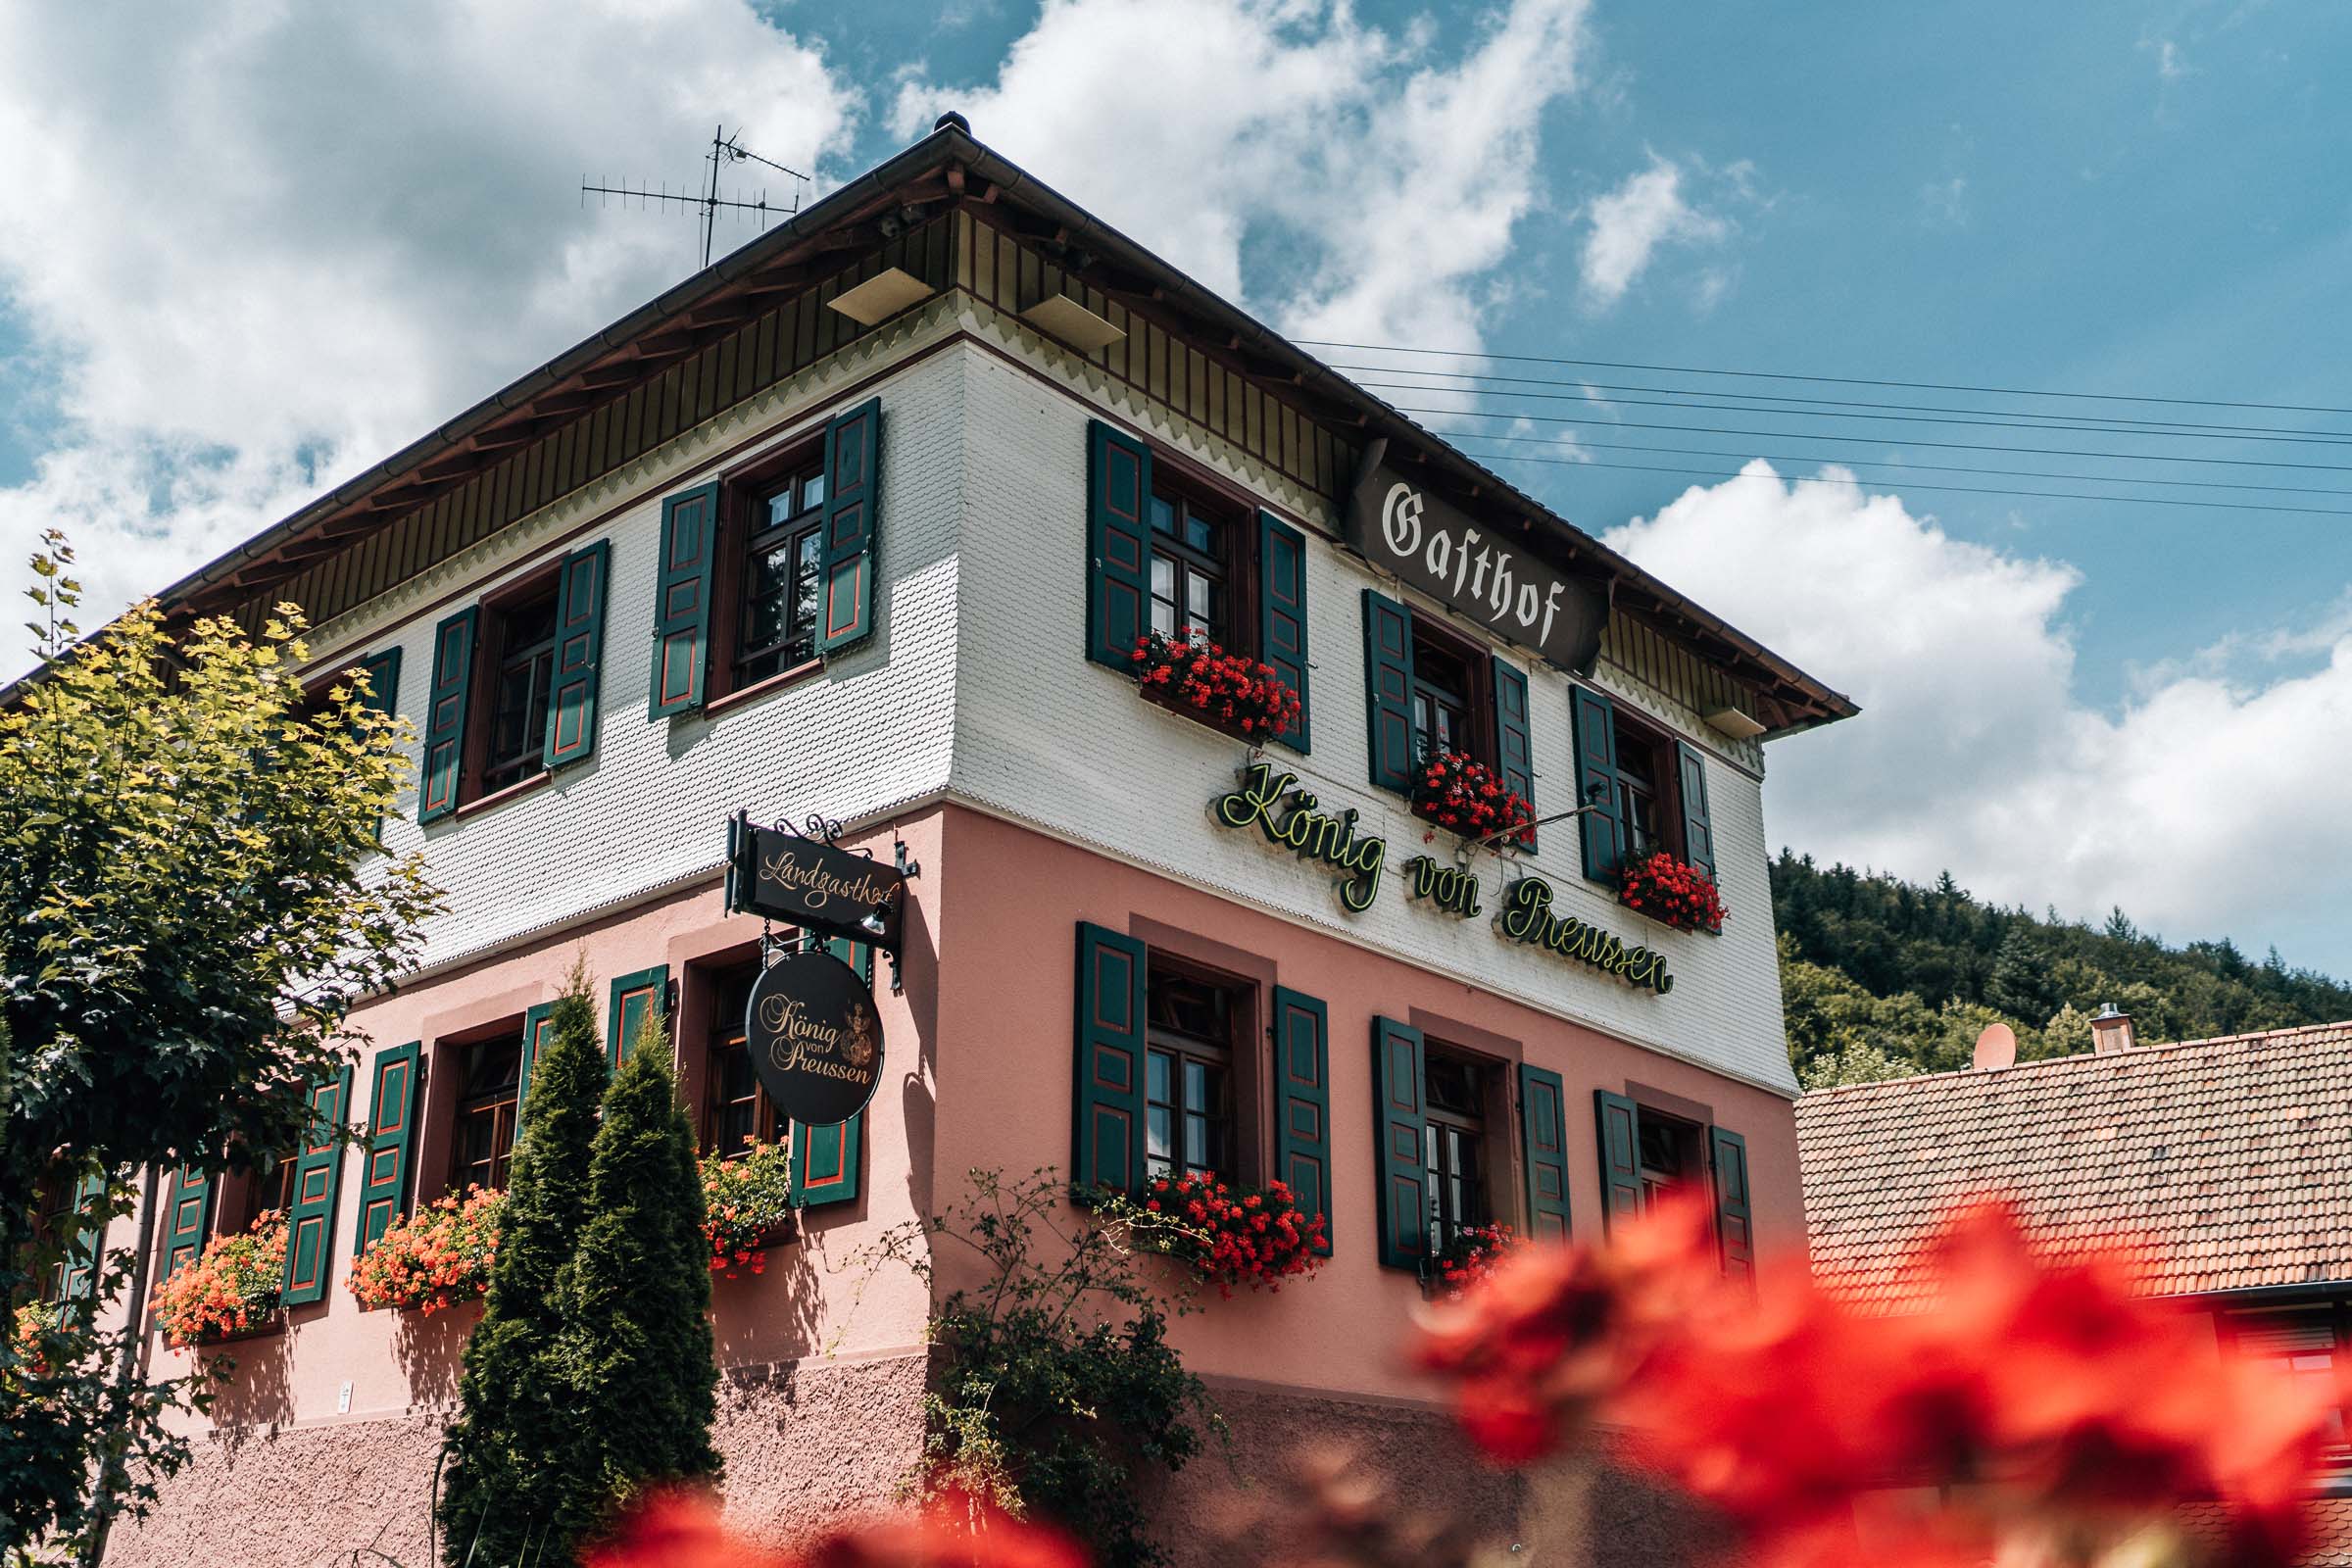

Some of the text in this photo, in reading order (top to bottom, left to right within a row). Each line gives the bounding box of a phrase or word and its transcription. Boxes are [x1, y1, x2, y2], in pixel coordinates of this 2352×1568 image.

[1217, 761, 1673, 993] König von Preussen
[760, 993, 840, 1053] König
[806, 1041, 825, 1054] von
[770, 1036, 871, 1084] Preussen
